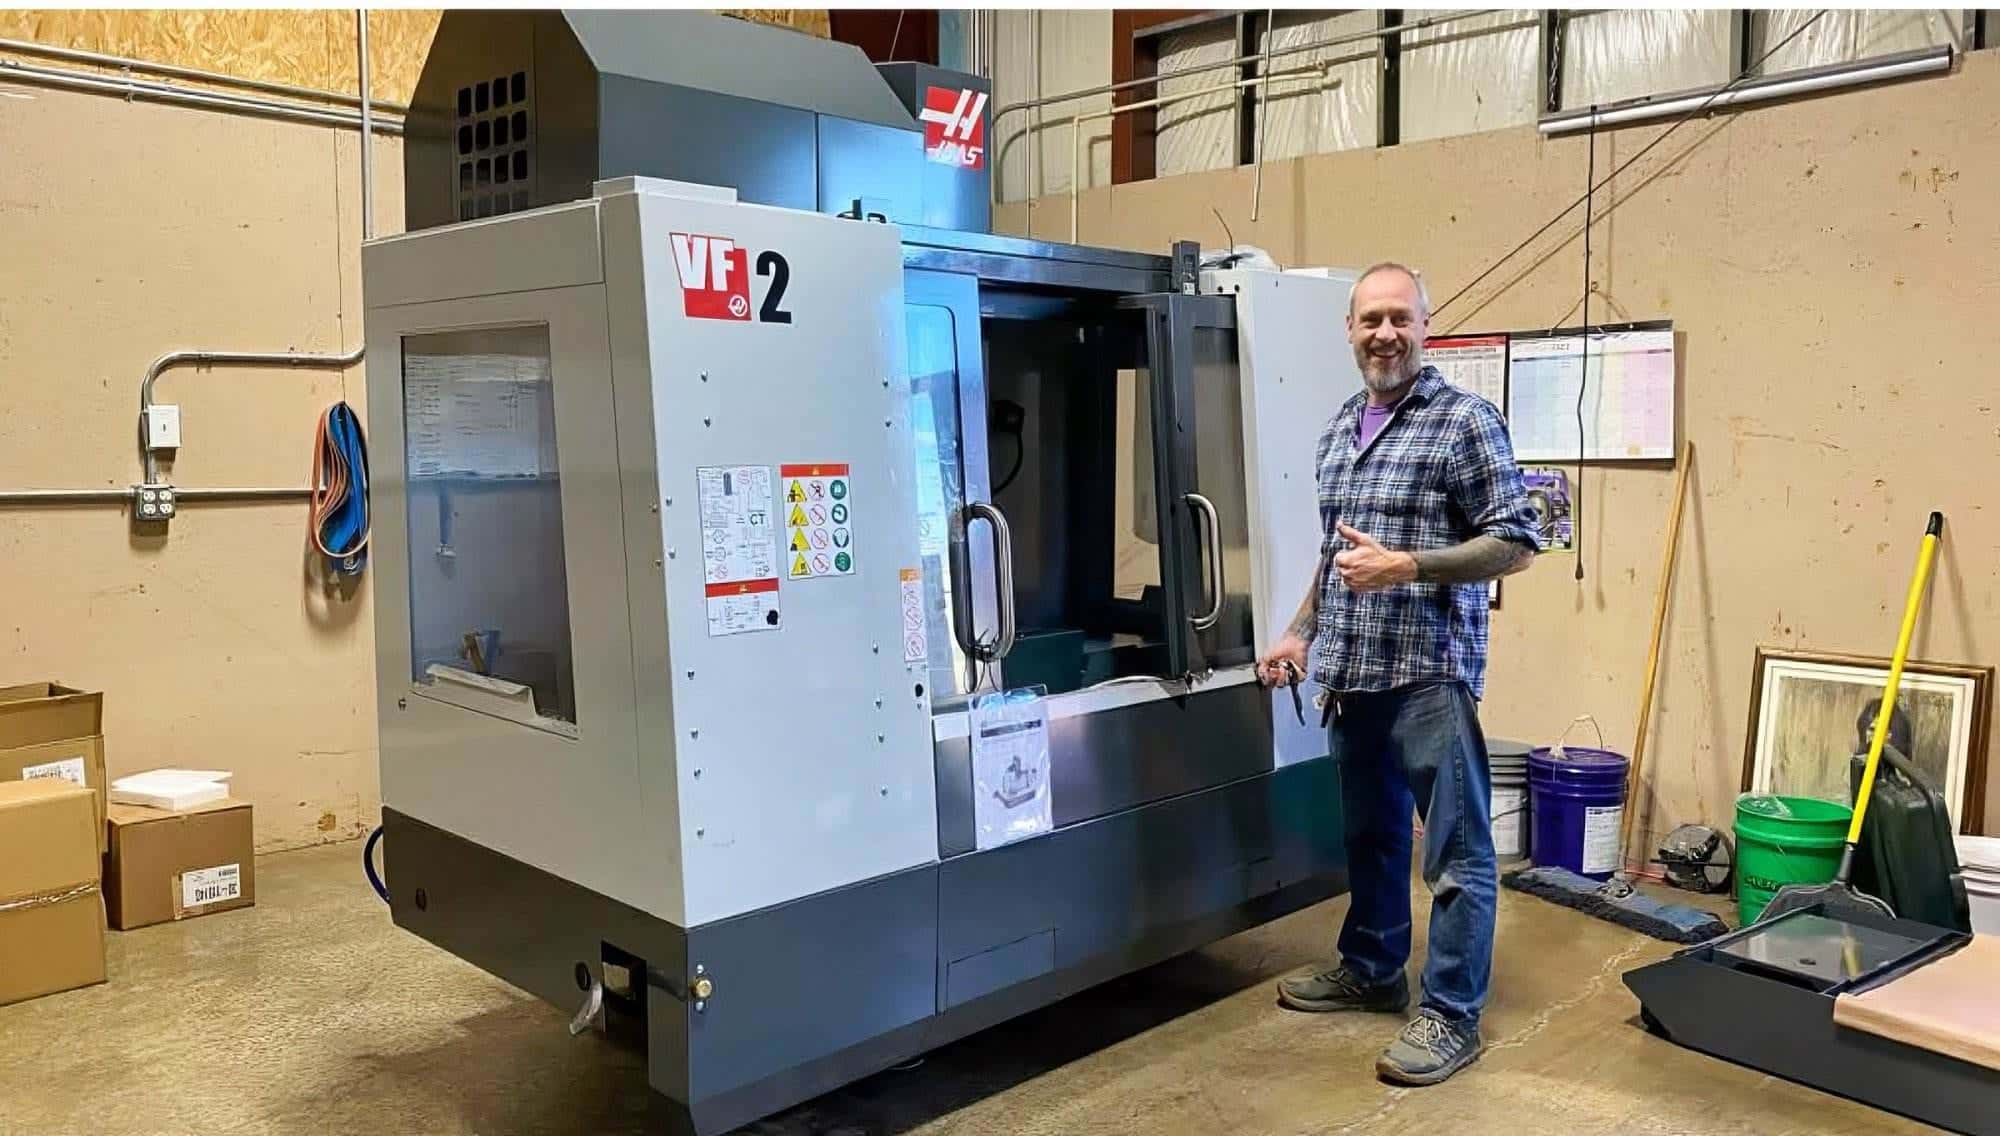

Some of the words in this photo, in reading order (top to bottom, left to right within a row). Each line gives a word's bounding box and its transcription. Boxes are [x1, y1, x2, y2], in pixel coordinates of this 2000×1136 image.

[669, 232, 735, 291] VF
[756, 250, 792, 324] 2
[750, 513, 766, 526] CT
